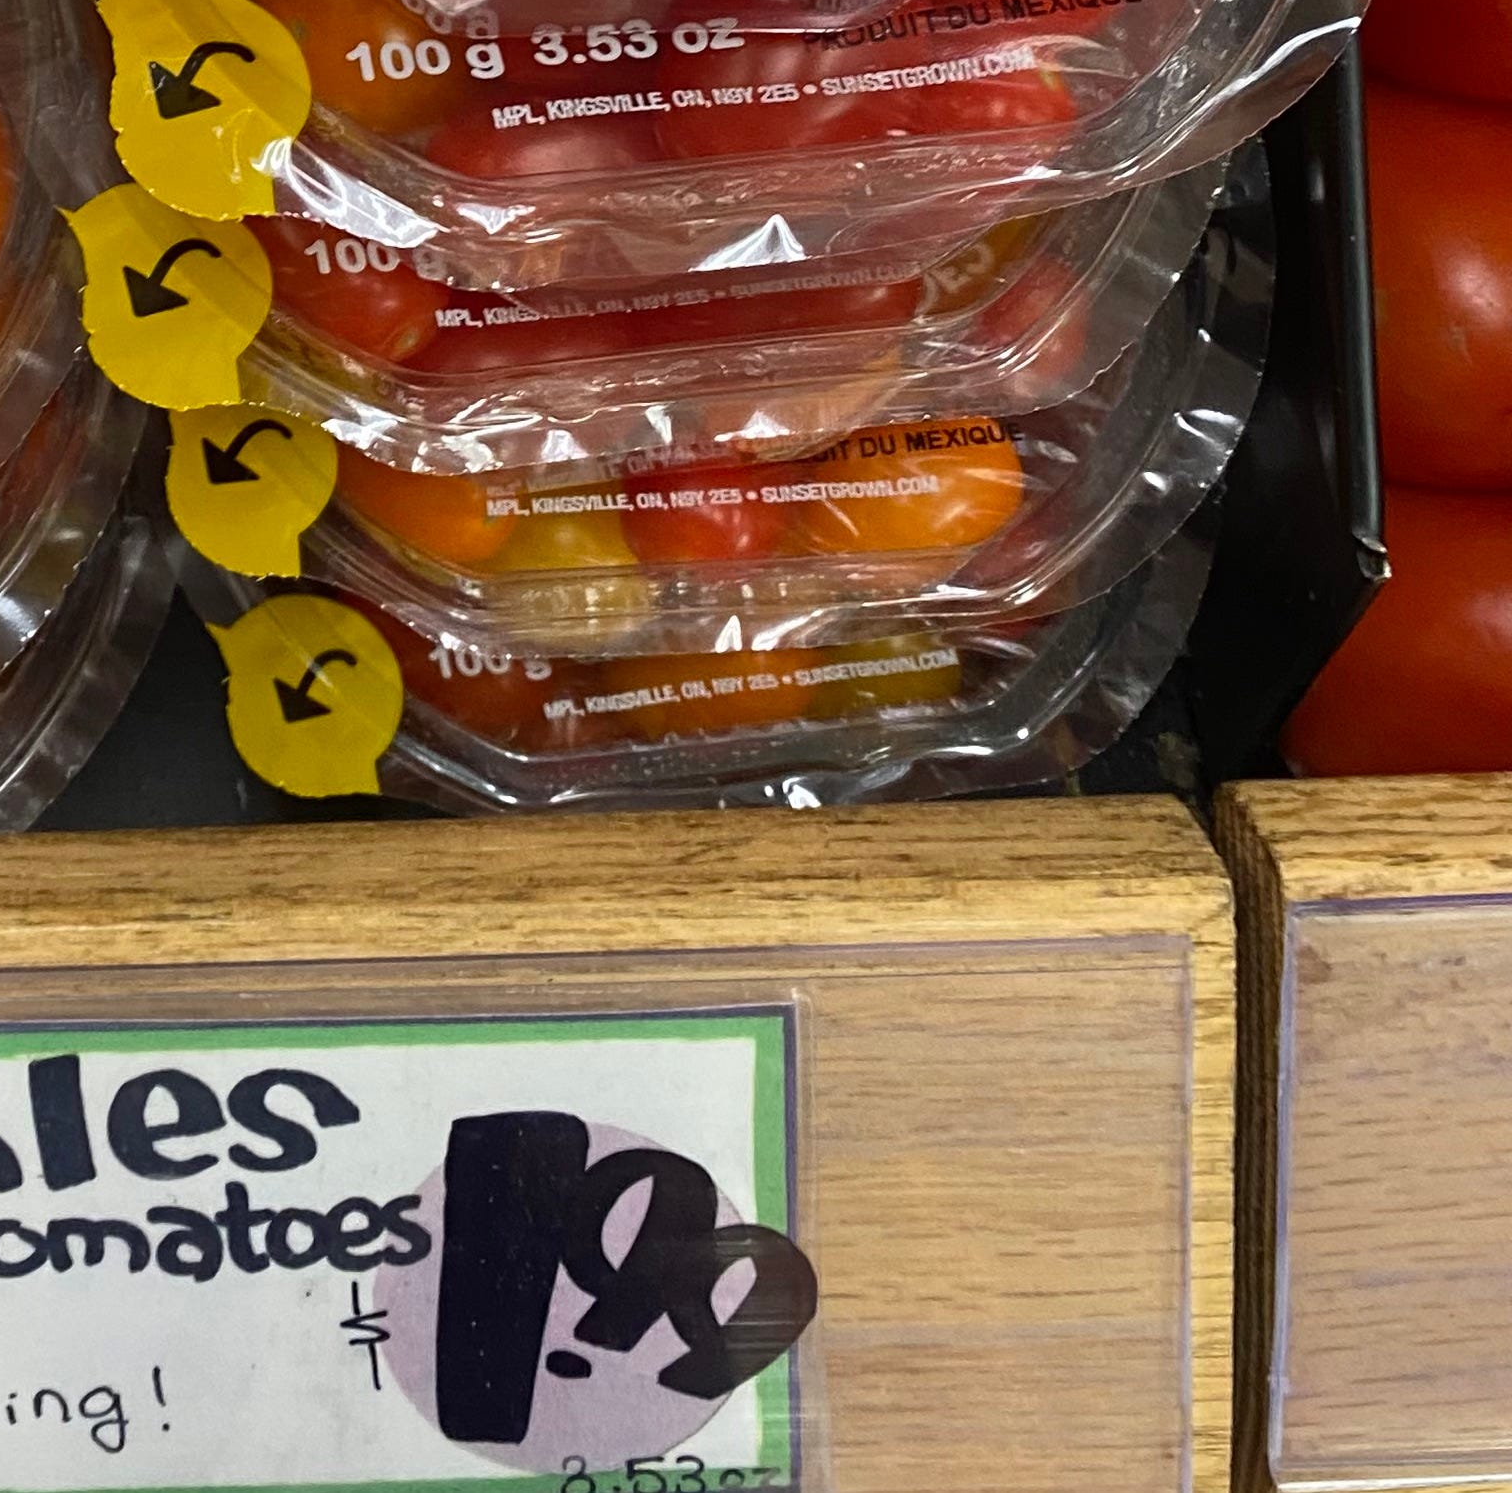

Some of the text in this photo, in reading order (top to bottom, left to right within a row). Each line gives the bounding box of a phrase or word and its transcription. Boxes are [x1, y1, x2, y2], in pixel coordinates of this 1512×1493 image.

[948, 4, 991, 29] DU
[346, 18, 745, 82] 100 g 3.53 oz
[546, 92, 671, 121] KINGSVILLE,
[822, 47, 1036, 96] SUNSETGROWN.COM
[304, 238, 401, 274] 100
[858, 433, 897, 457] DU
[531, 491, 634, 514] KINGSVILLE,
[761, 474, 939, 504] SUNSETGROWN.COM
[586, 684, 680, 714] KINGSVILLE,
